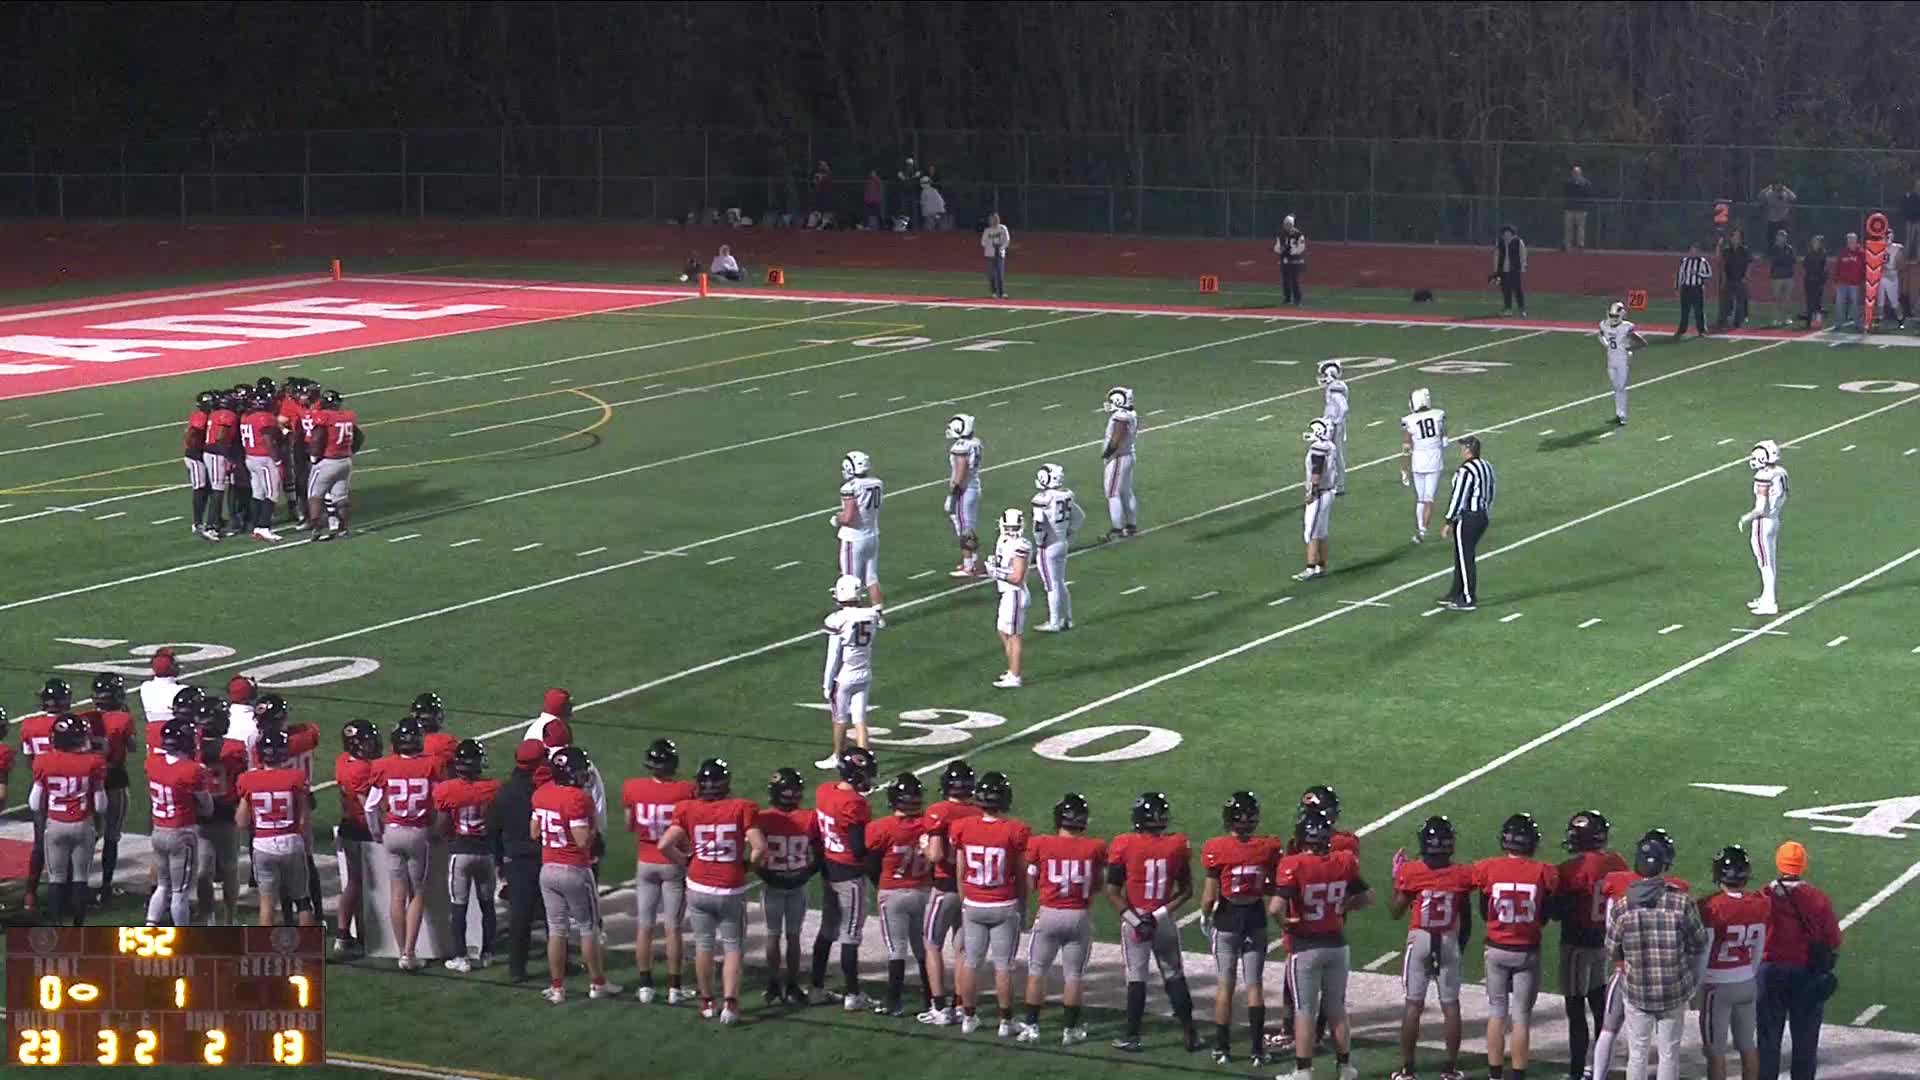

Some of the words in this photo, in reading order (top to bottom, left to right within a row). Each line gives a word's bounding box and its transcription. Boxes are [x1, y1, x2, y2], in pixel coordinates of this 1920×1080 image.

[1630, 293, 1645, 307] 20
[0, 297, 506, 374] ADE
[1416, 417, 1436, 439] 18
[866, 486, 881, 510] 70
[852, 621, 872, 647] 15
[47, 776, 90, 812] 24
[150, 780, 177, 818] 21
[252, 791, 295, 829] 23
[388, 778, 429, 817] 22
[532, 807, 568, 848] 75
[964, 845, 1006, 886] 50
[1048, 859, 1092, 899] 44
[1144, 858, 1168, 899] 11
[1303, 880, 1348, 921] 59
[1420, 889, 1453, 928] 13
